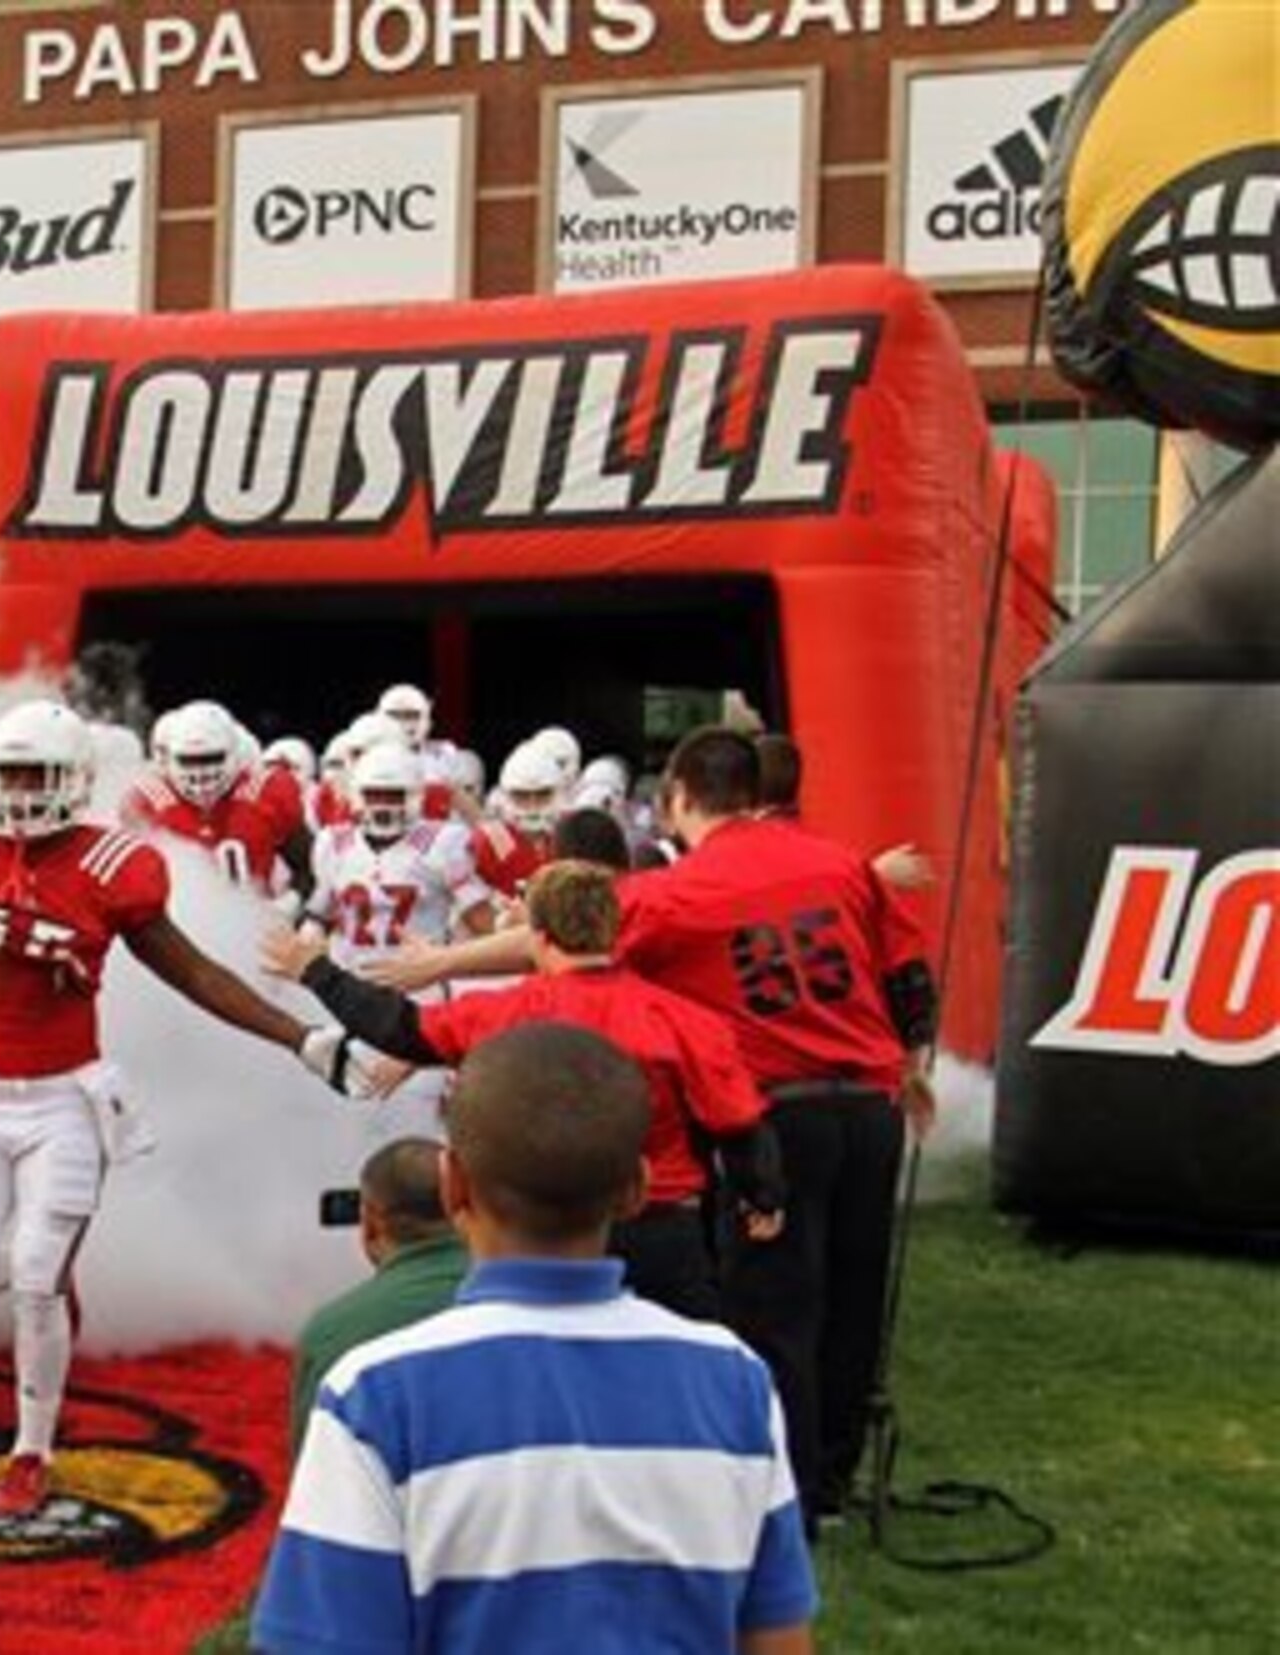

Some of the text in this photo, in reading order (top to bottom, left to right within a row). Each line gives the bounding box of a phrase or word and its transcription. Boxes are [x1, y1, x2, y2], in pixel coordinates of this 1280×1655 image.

[23, 13, 259, 102] PAPA
[313, 183, 436, 237] PNC
[558, 203, 798, 246] KentuckyOne
[23, 329, 866, 530] LOUISVILLE
[1028, 845, 1280, 1066] LO
